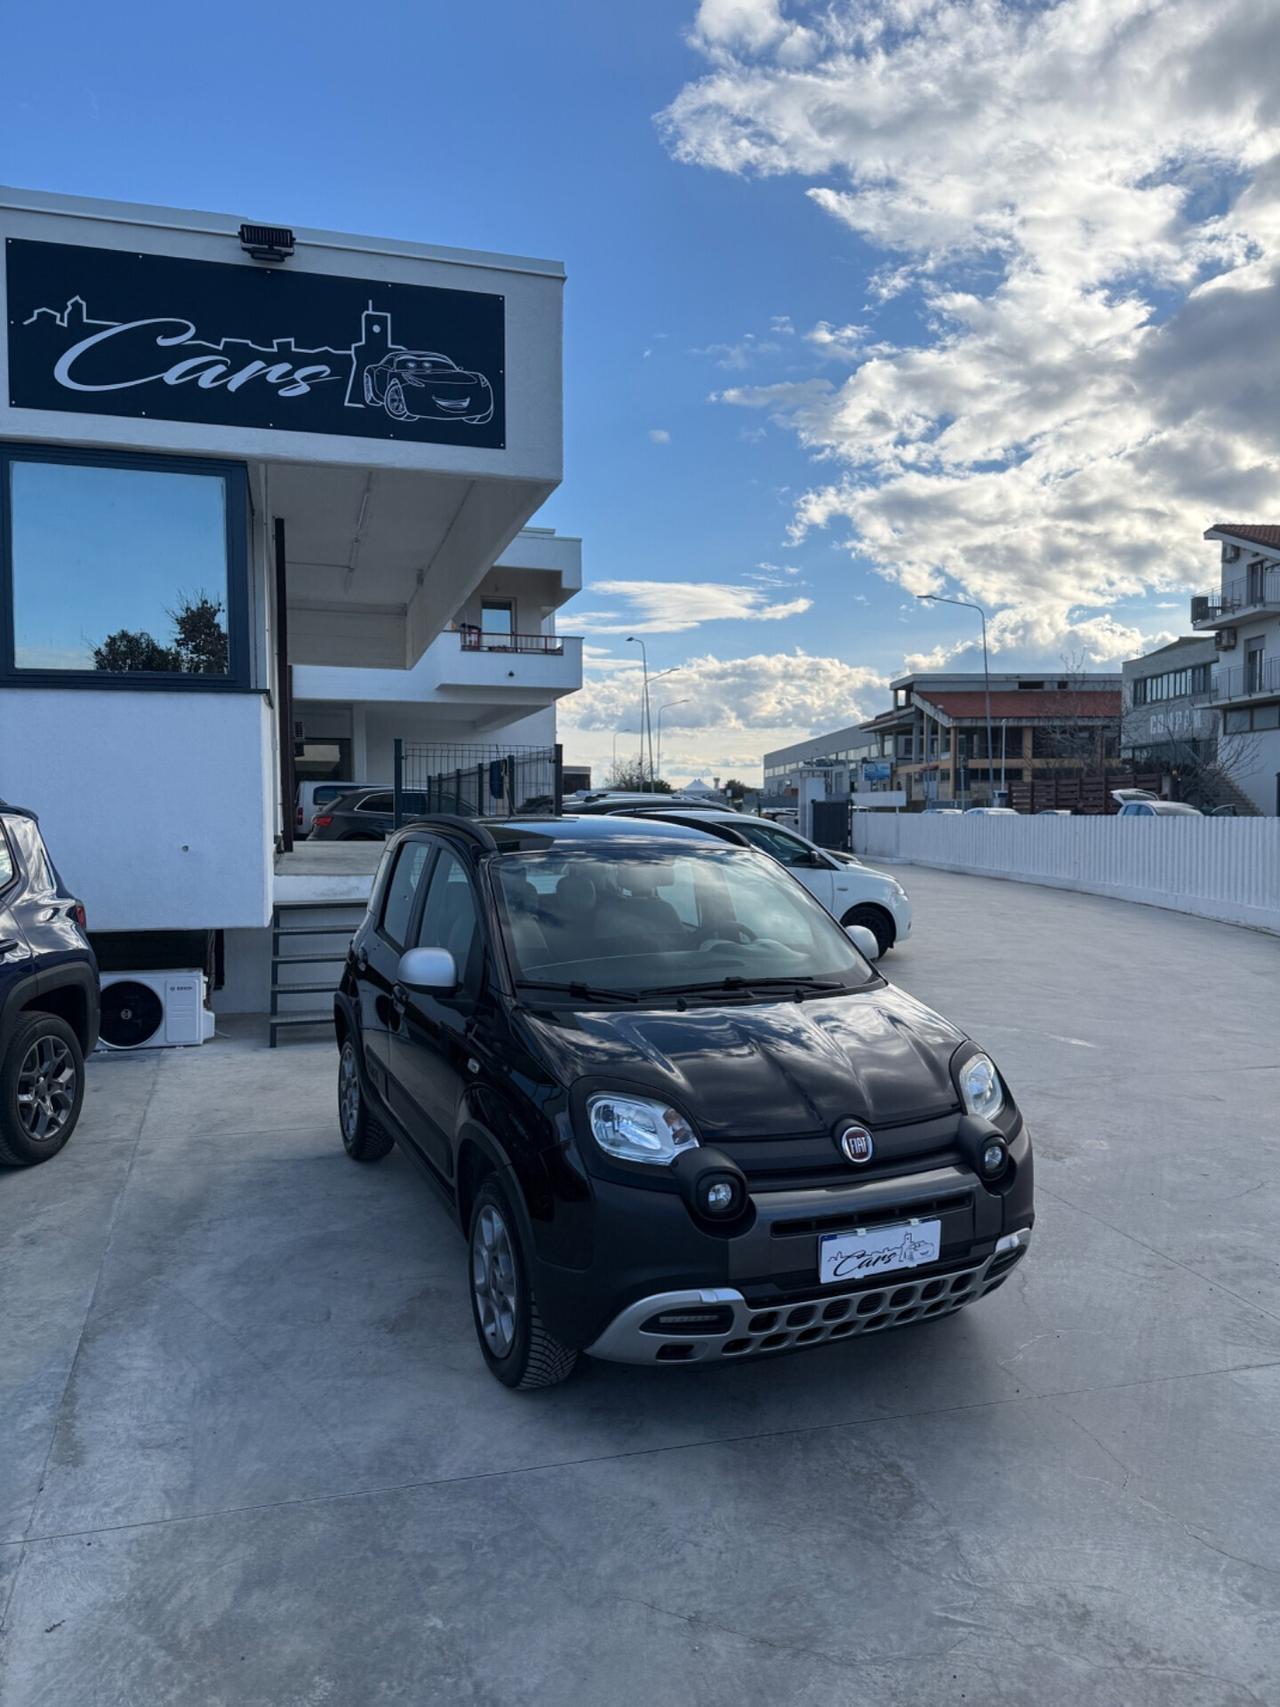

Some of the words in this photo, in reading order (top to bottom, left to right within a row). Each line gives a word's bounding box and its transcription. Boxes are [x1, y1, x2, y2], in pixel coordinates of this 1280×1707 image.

[54, 318, 342, 397] Cars
[848, 1137, 867, 1154] FIAT
[833, 1250, 897, 1277] Cars
